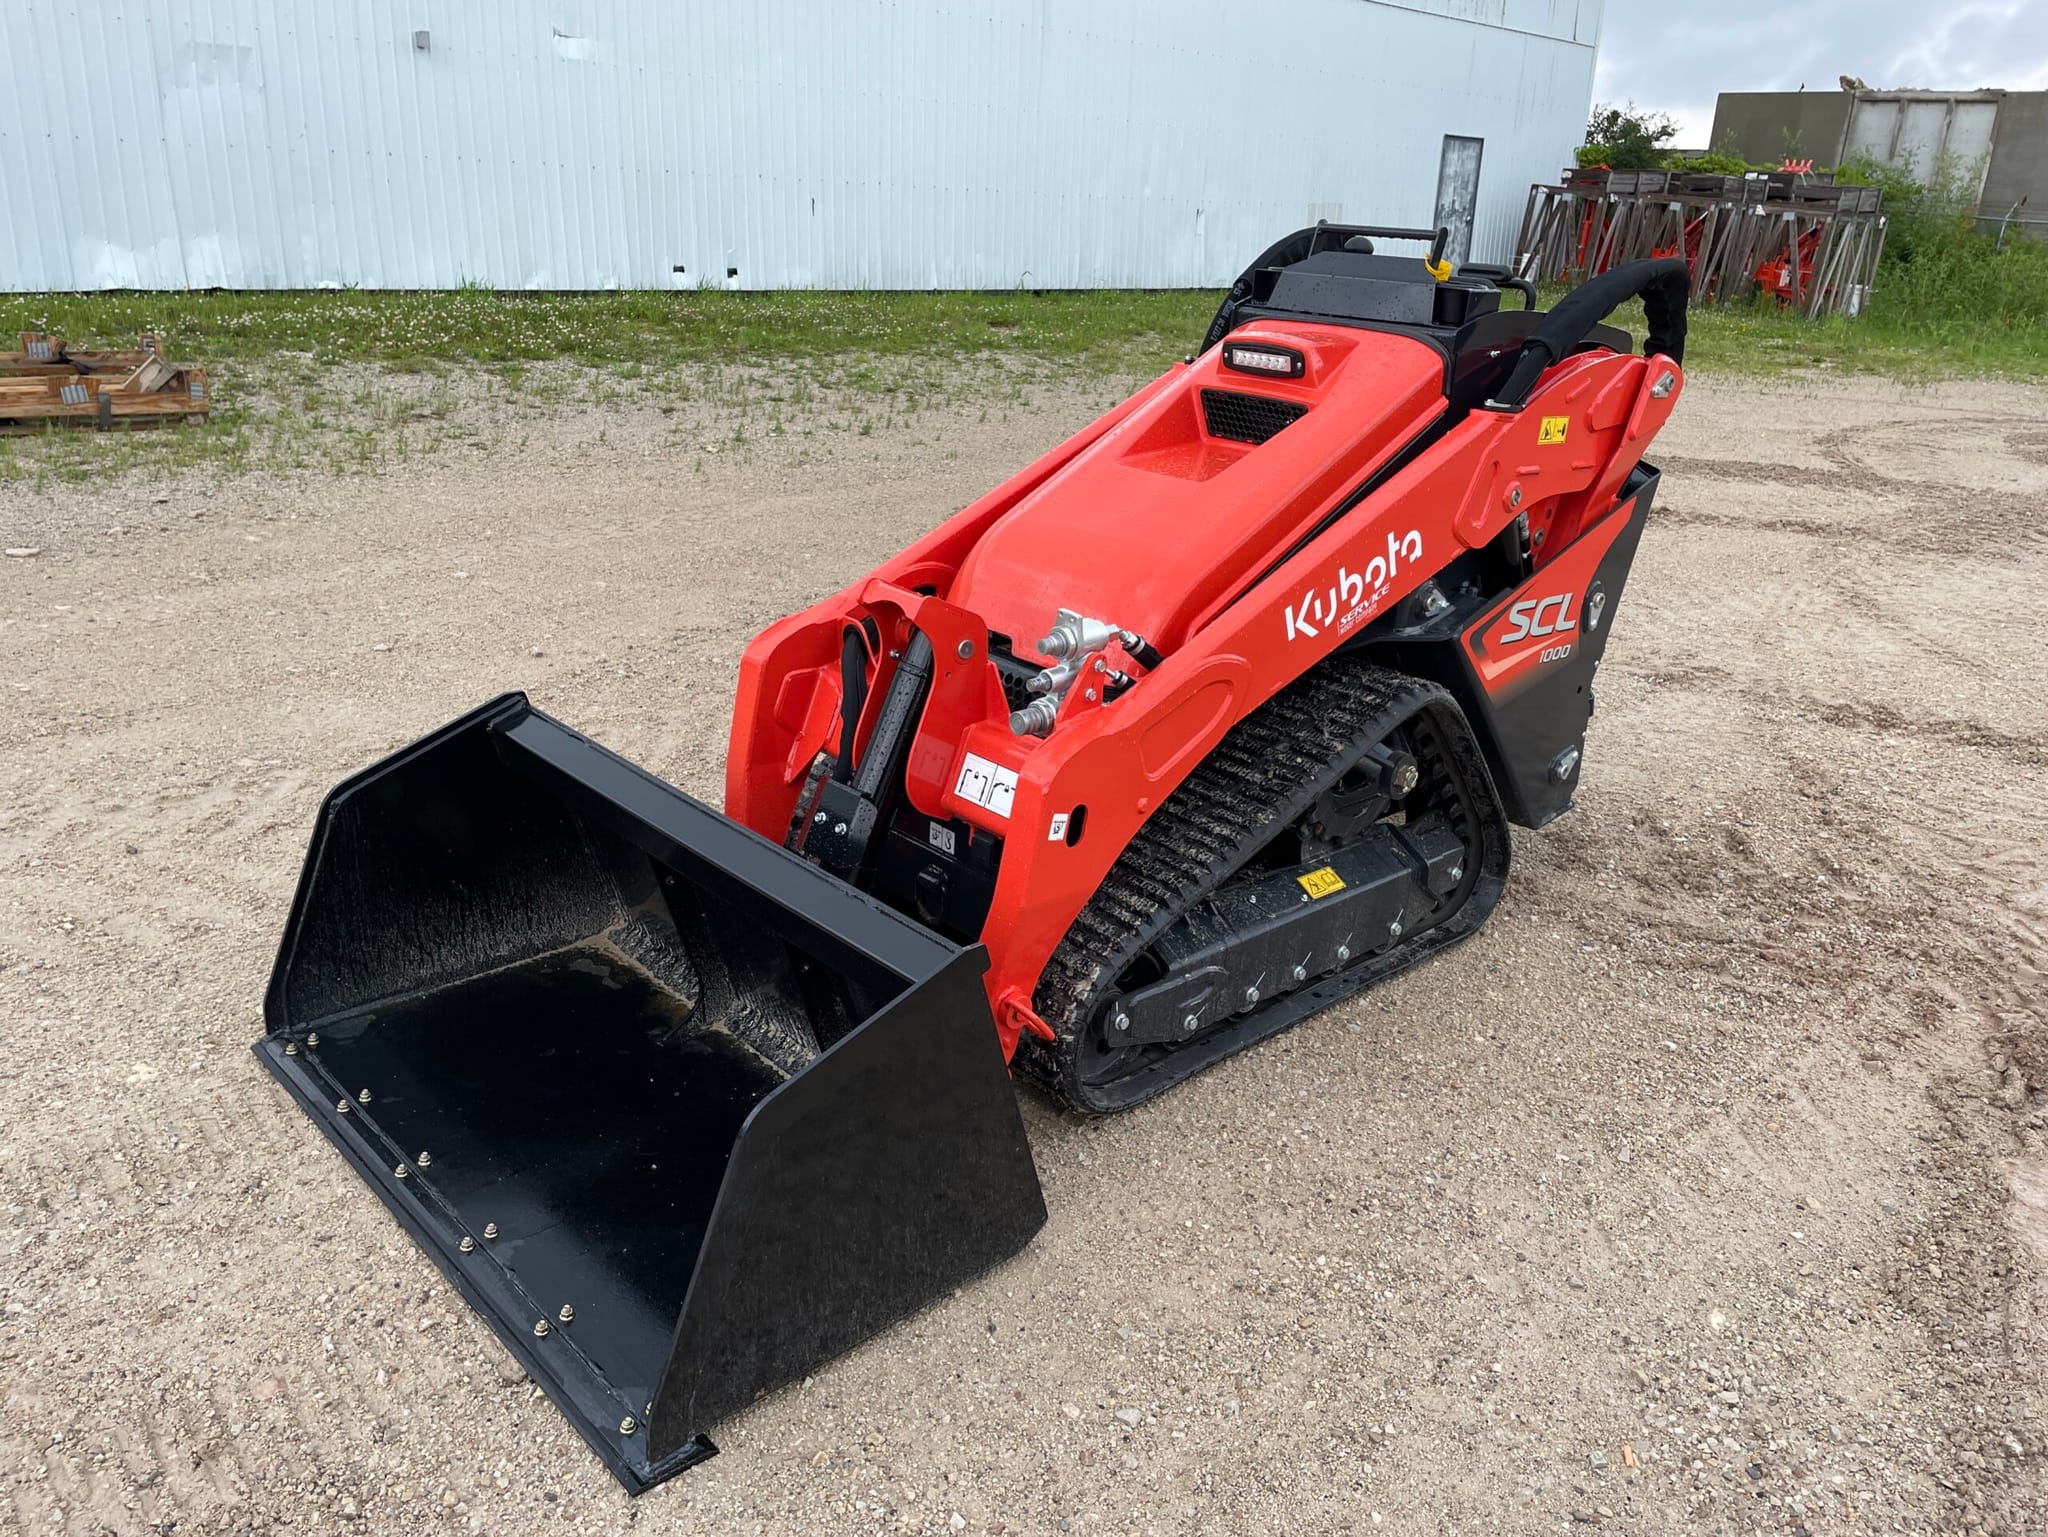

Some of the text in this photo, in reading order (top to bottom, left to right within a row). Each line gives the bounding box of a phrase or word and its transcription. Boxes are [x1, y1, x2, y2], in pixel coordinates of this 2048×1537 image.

[1285, 530, 1422, 641] Kubota
[1340, 582, 1391, 626] SERVICE
[1500, 592, 1577, 645] SCL
[1539, 644, 1571, 664] 1000
